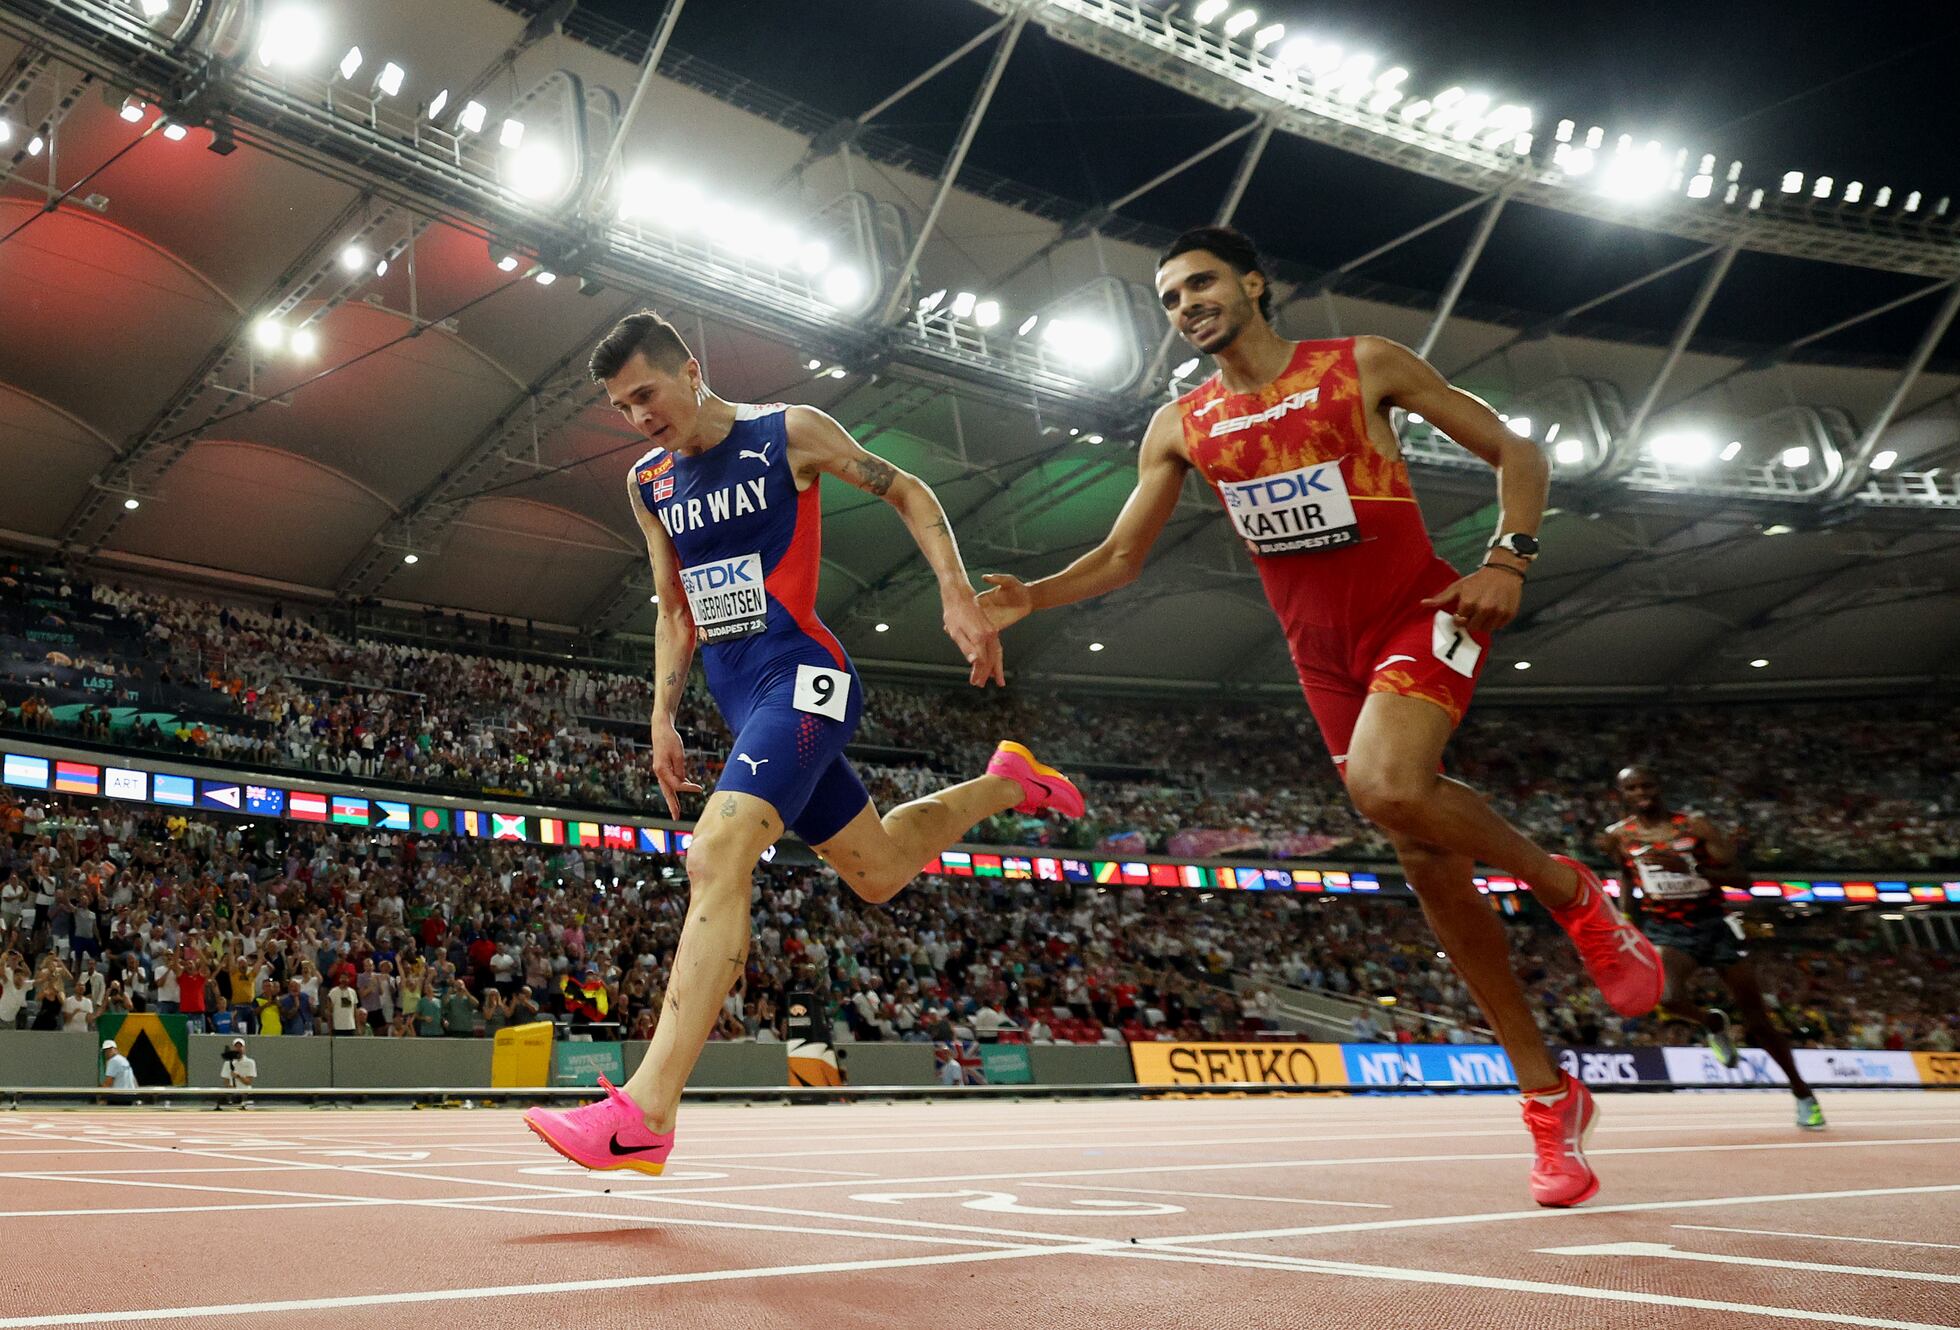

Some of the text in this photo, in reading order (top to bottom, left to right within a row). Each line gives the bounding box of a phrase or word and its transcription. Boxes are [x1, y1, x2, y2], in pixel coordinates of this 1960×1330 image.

[1237, 468, 1333, 506] TDK
[658, 476, 767, 537] NORWAY
[1240, 503, 1326, 537] KATIR
[1260, 531, 1352, 553] BUDAPEST 23
[690, 559, 754, 592] TDK
[707, 621, 749, 637] BUDAPEST
[1445, 631, 1463, 661] 1
[812, 674, 835, 706] 9
[113, 777, 140, 791] ART
[1169, 1048, 1319, 1084] SEIKO
[1358, 1053, 1424, 1084] NTN
[1448, 1053, 1511, 1084] NTN
[1581, 1053, 1638, 1083] asics
[849, 1189, 1187, 1216] 2
